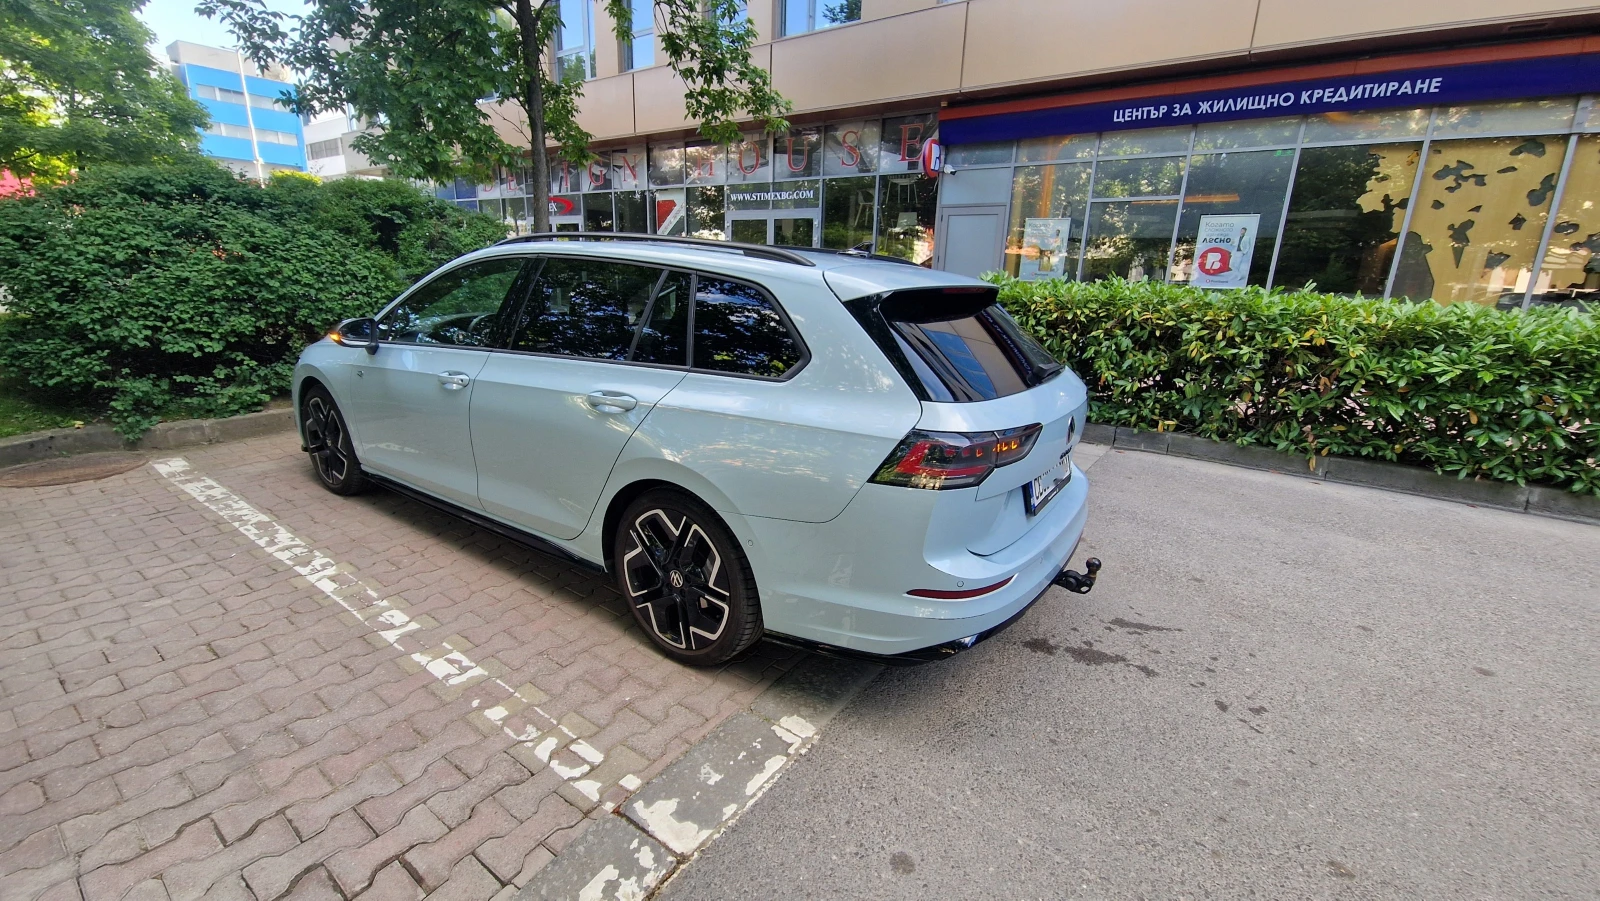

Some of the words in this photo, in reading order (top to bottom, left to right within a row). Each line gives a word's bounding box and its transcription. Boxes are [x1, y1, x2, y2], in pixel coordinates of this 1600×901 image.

[1113, 104, 1168, 123] ЦЕНТЪР
[1171, 103, 1192, 117] ЗА
[1196, 92, 1295, 115] ЖИЛИЩНО
[1300, 77, 1443, 105] КРЕДИТИРАНЕ
[696, 122, 924, 177] HOUSE
[730, 189, 814, 201] WWW.STIMEXBG.COM
